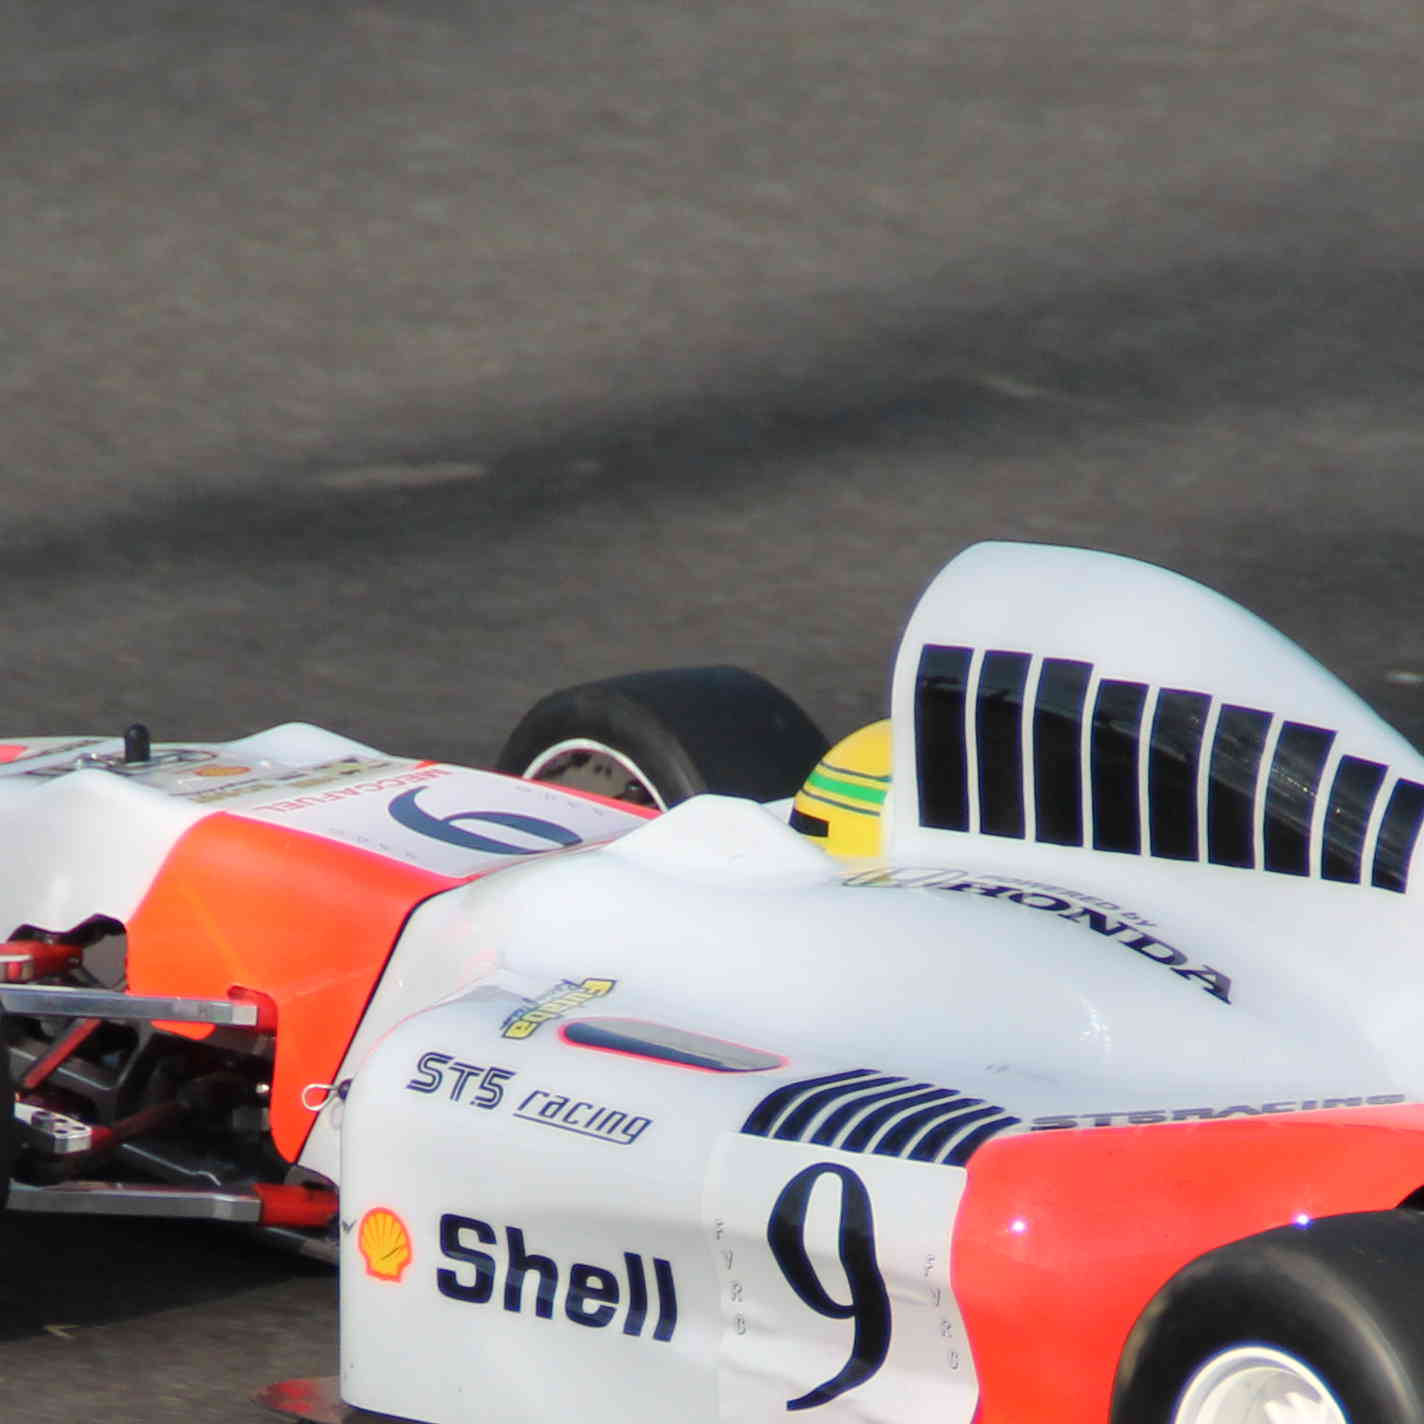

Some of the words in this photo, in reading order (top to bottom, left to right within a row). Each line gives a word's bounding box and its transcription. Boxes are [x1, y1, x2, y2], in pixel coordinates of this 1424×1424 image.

[940, 879, 1233, 1006] HONDA
[512, 1089, 655, 1146] racing
[435, 1211, 679, 1344] Shell
[767, 1161, 893, 1412] 9
